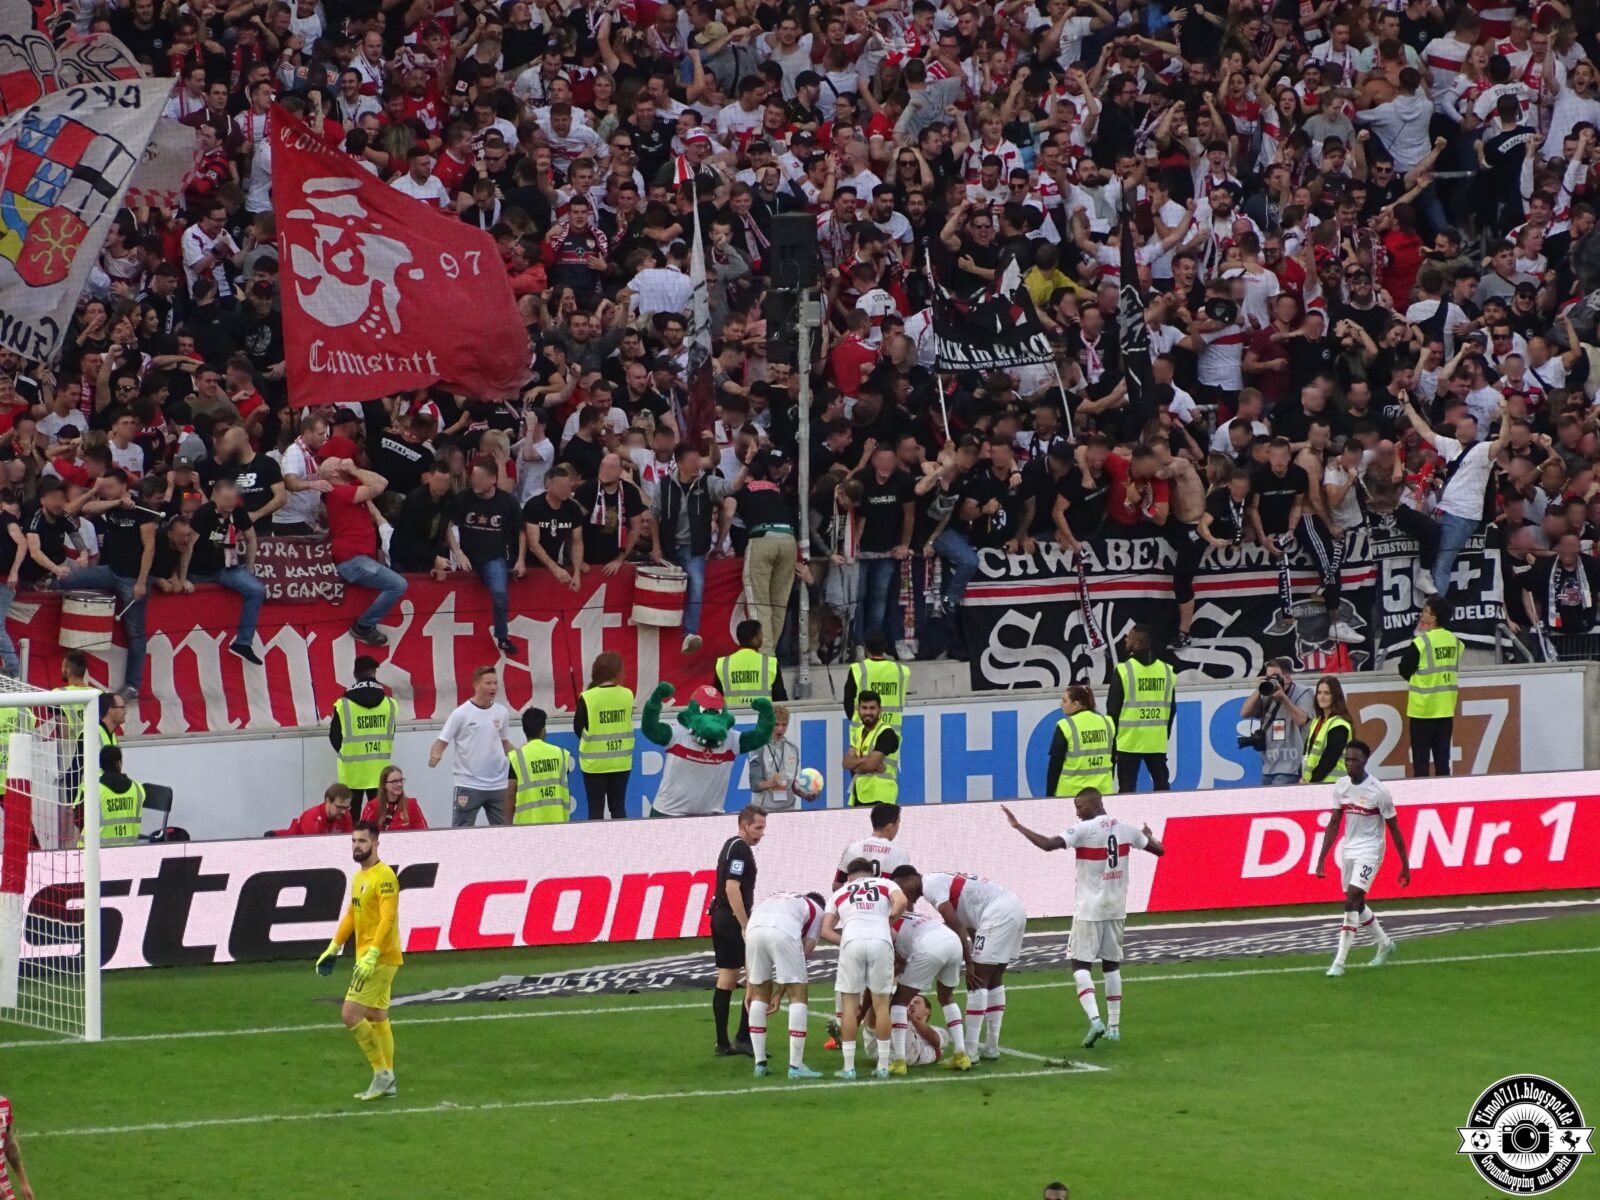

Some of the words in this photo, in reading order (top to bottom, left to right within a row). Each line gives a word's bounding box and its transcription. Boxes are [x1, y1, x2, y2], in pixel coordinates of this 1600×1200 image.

[439, 250, 481, 279] 97
[309, 339, 440, 376] Cannstatt
[236, 541, 299, 559] UTRA
[977, 536, 1179, 579] CHWABEN
[253, 563, 277, 578] ER
[731, 670, 760, 684] SECURITY
[1138, 677, 1166, 692] SECURITY
[599, 709, 627, 724] SECURITY
[1139, 707, 1161, 719] 3202
[357, 714, 386, 730] SECURITY
[1081, 729, 1107, 744] SECURITY
[1359, 698, 1510, 778] 27
[606, 739, 622, 751] 1837
[530, 758, 560, 775] SECURITY
[1087, 756, 1104, 768] 1447
[539, 786, 557, 798] 1467
[106, 798, 134, 812] SECURITY
[114, 824, 127, 836] 181
[1107, 834, 1118, 869] 9
[1241, 811, 1344, 879] Di
[1360, 864, 1373, 881] 32
[847, 880, 880, 904] 25
[974, 935, 986, 951] 23
